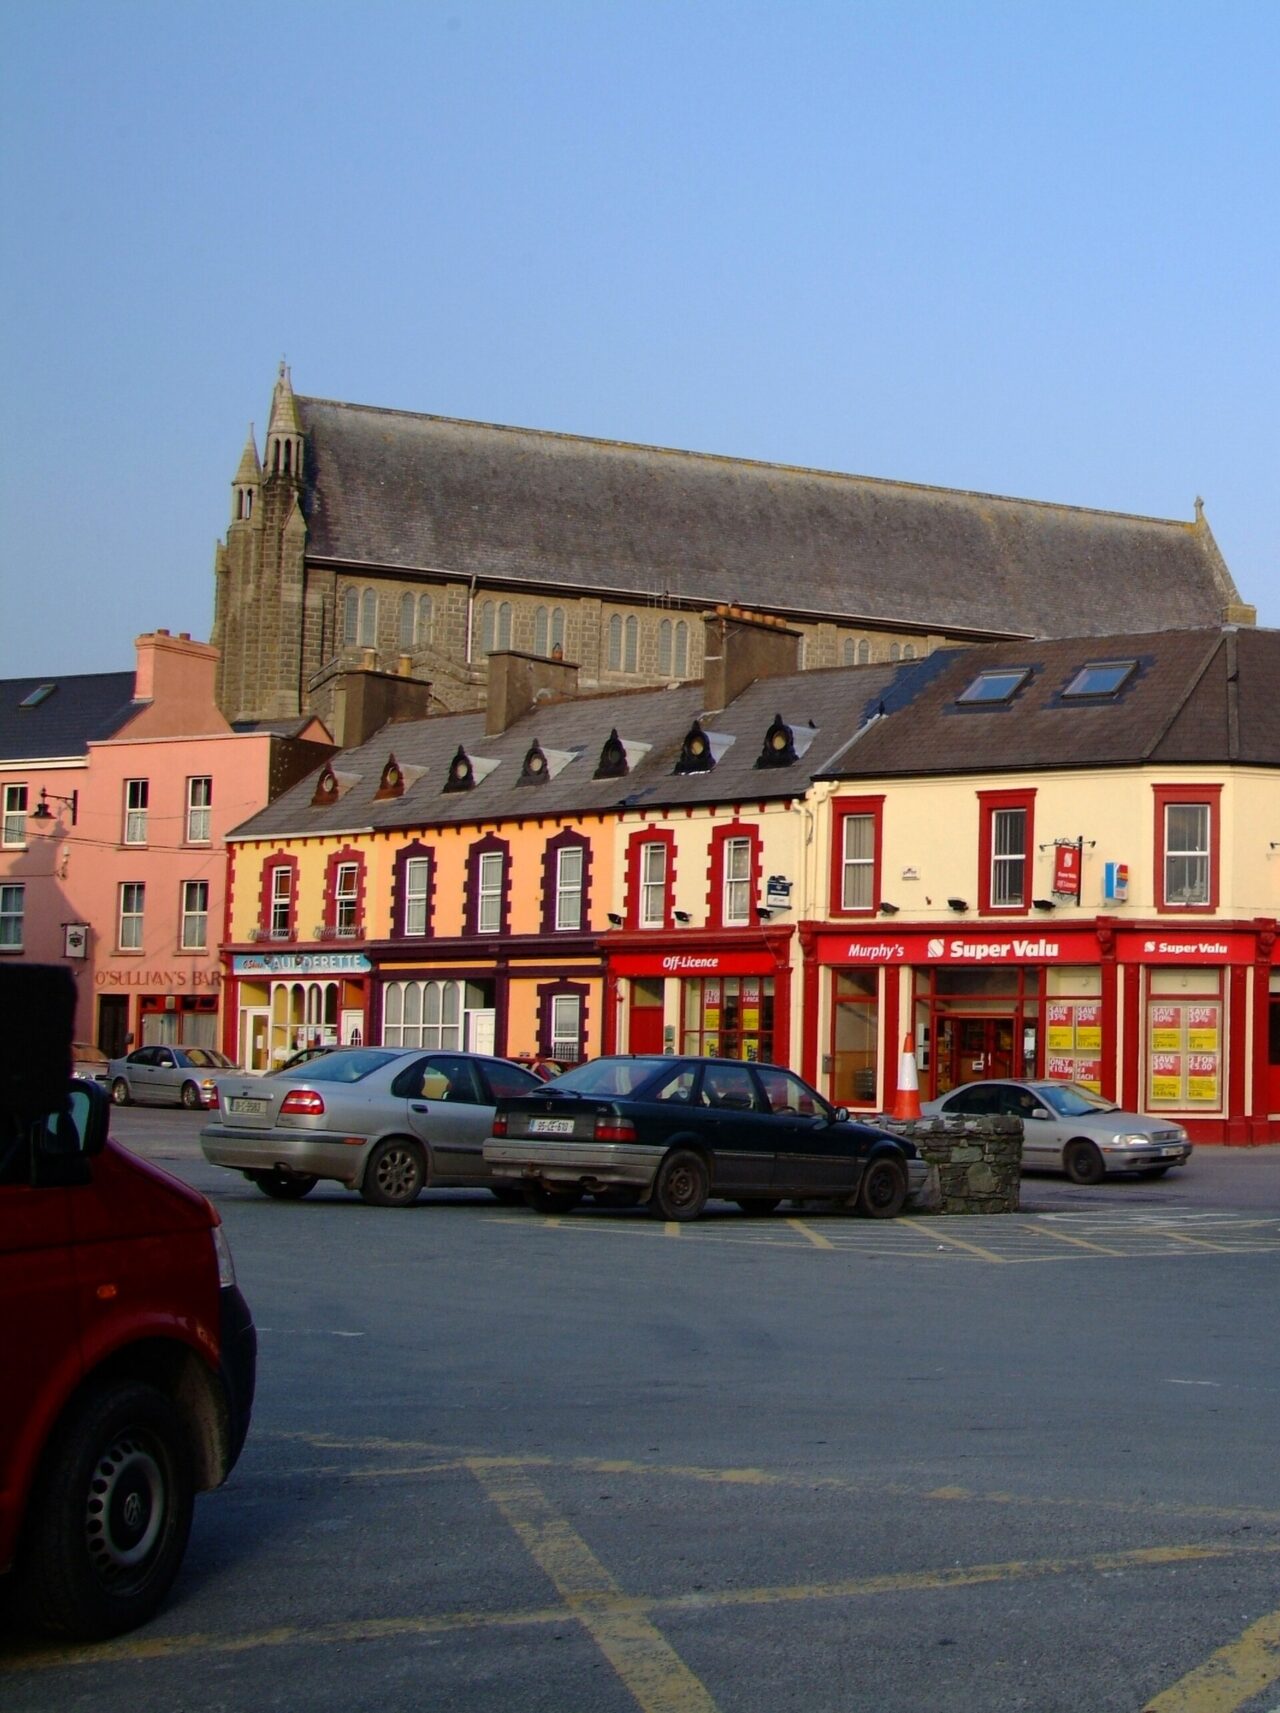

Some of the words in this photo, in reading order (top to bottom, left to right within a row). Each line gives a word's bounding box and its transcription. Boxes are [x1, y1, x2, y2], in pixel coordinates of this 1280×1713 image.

[848, 943, 904, 960] Murphy's
[950, 940, 1010, 960] Super
[1012, 939, 1059, 957] Valu
[1159, 942, 1198, 954] Super
[1198, 943, 1228, 954] Valu
[265, 954, 361, 970] AUDERETTE
[662, 956, 719, 970] Off-Licence
[95, 970, 186, 986] O'SULLIVAN'S
[192, 970, 221, 987] BAR
[1049, 1006, 1068, 1014] SAVE
[1078, 1006, 1097, 1014] SAVE
[1153, 1008, 1175, 1016] SAVE
[1190, 1008, 1211, 1016] SAVE
[1154, 1056, 1175, 1064] SAVE
